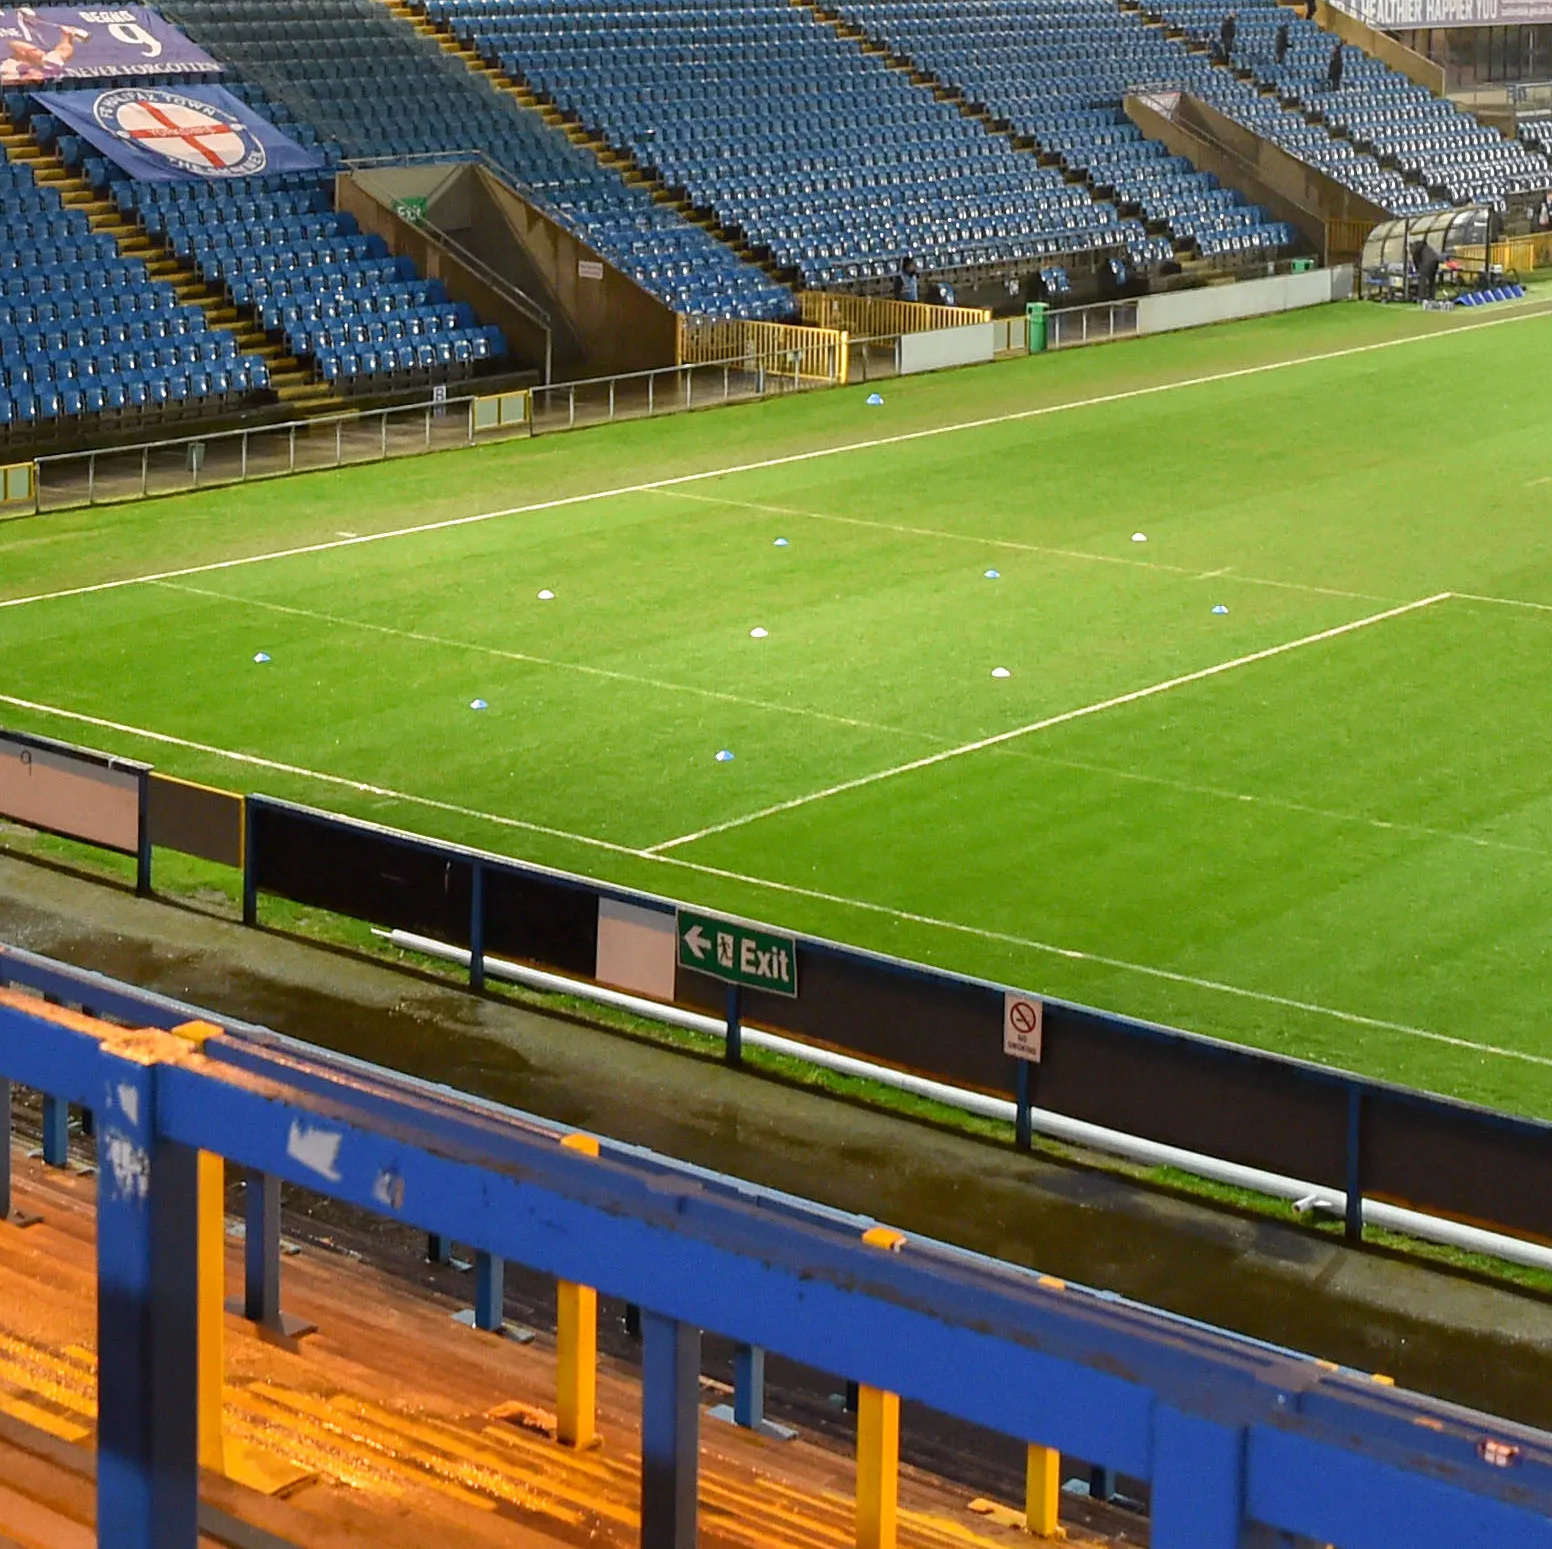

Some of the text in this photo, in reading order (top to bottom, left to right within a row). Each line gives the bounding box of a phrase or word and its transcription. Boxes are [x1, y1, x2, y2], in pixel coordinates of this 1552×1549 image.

[108, 23, 163, 58] 9
[65, 61, 222, 79] NEVER FORGOTTEN
[165, 95, 216, 117] TOWN
[740, 937, 790, 983] Exit
